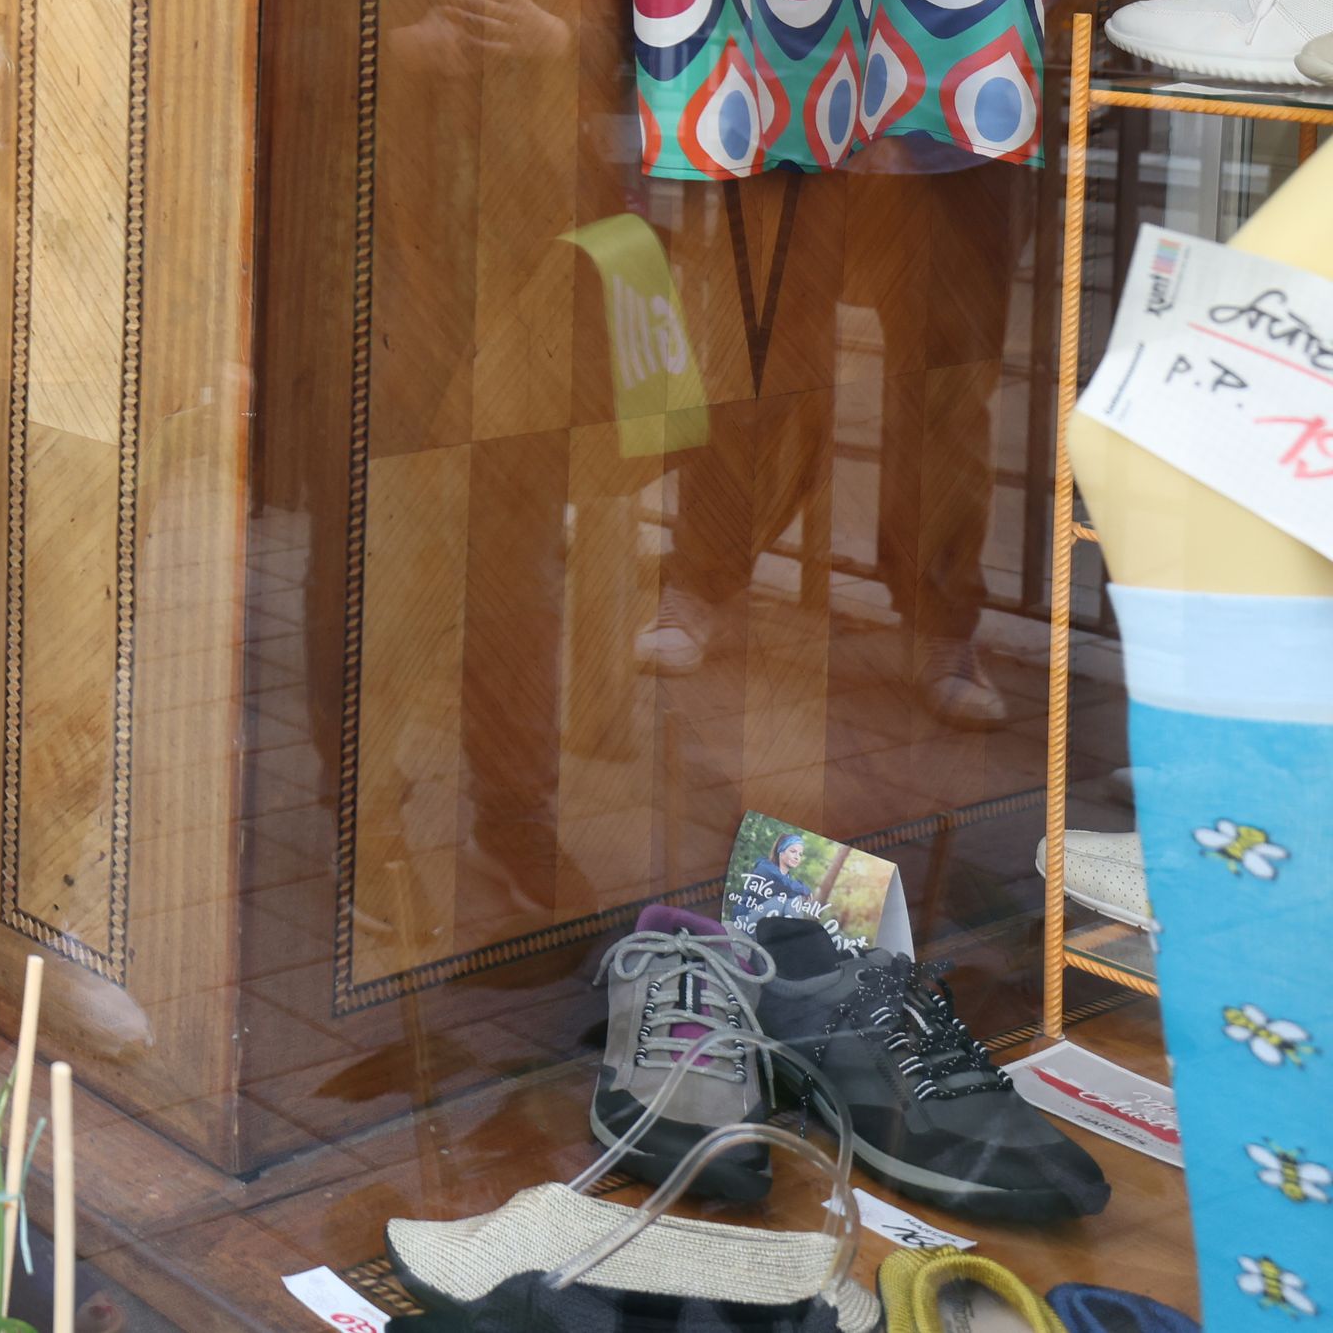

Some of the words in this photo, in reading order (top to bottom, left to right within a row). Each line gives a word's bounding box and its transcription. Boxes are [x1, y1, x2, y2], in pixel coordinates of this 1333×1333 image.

[728, 892, 743, 905] on
[745, 895, 765, 912] the
[741, 873, 774, 899] Take
[777, 892, 787, 904] a
[790, 895, 832, 919] walk
